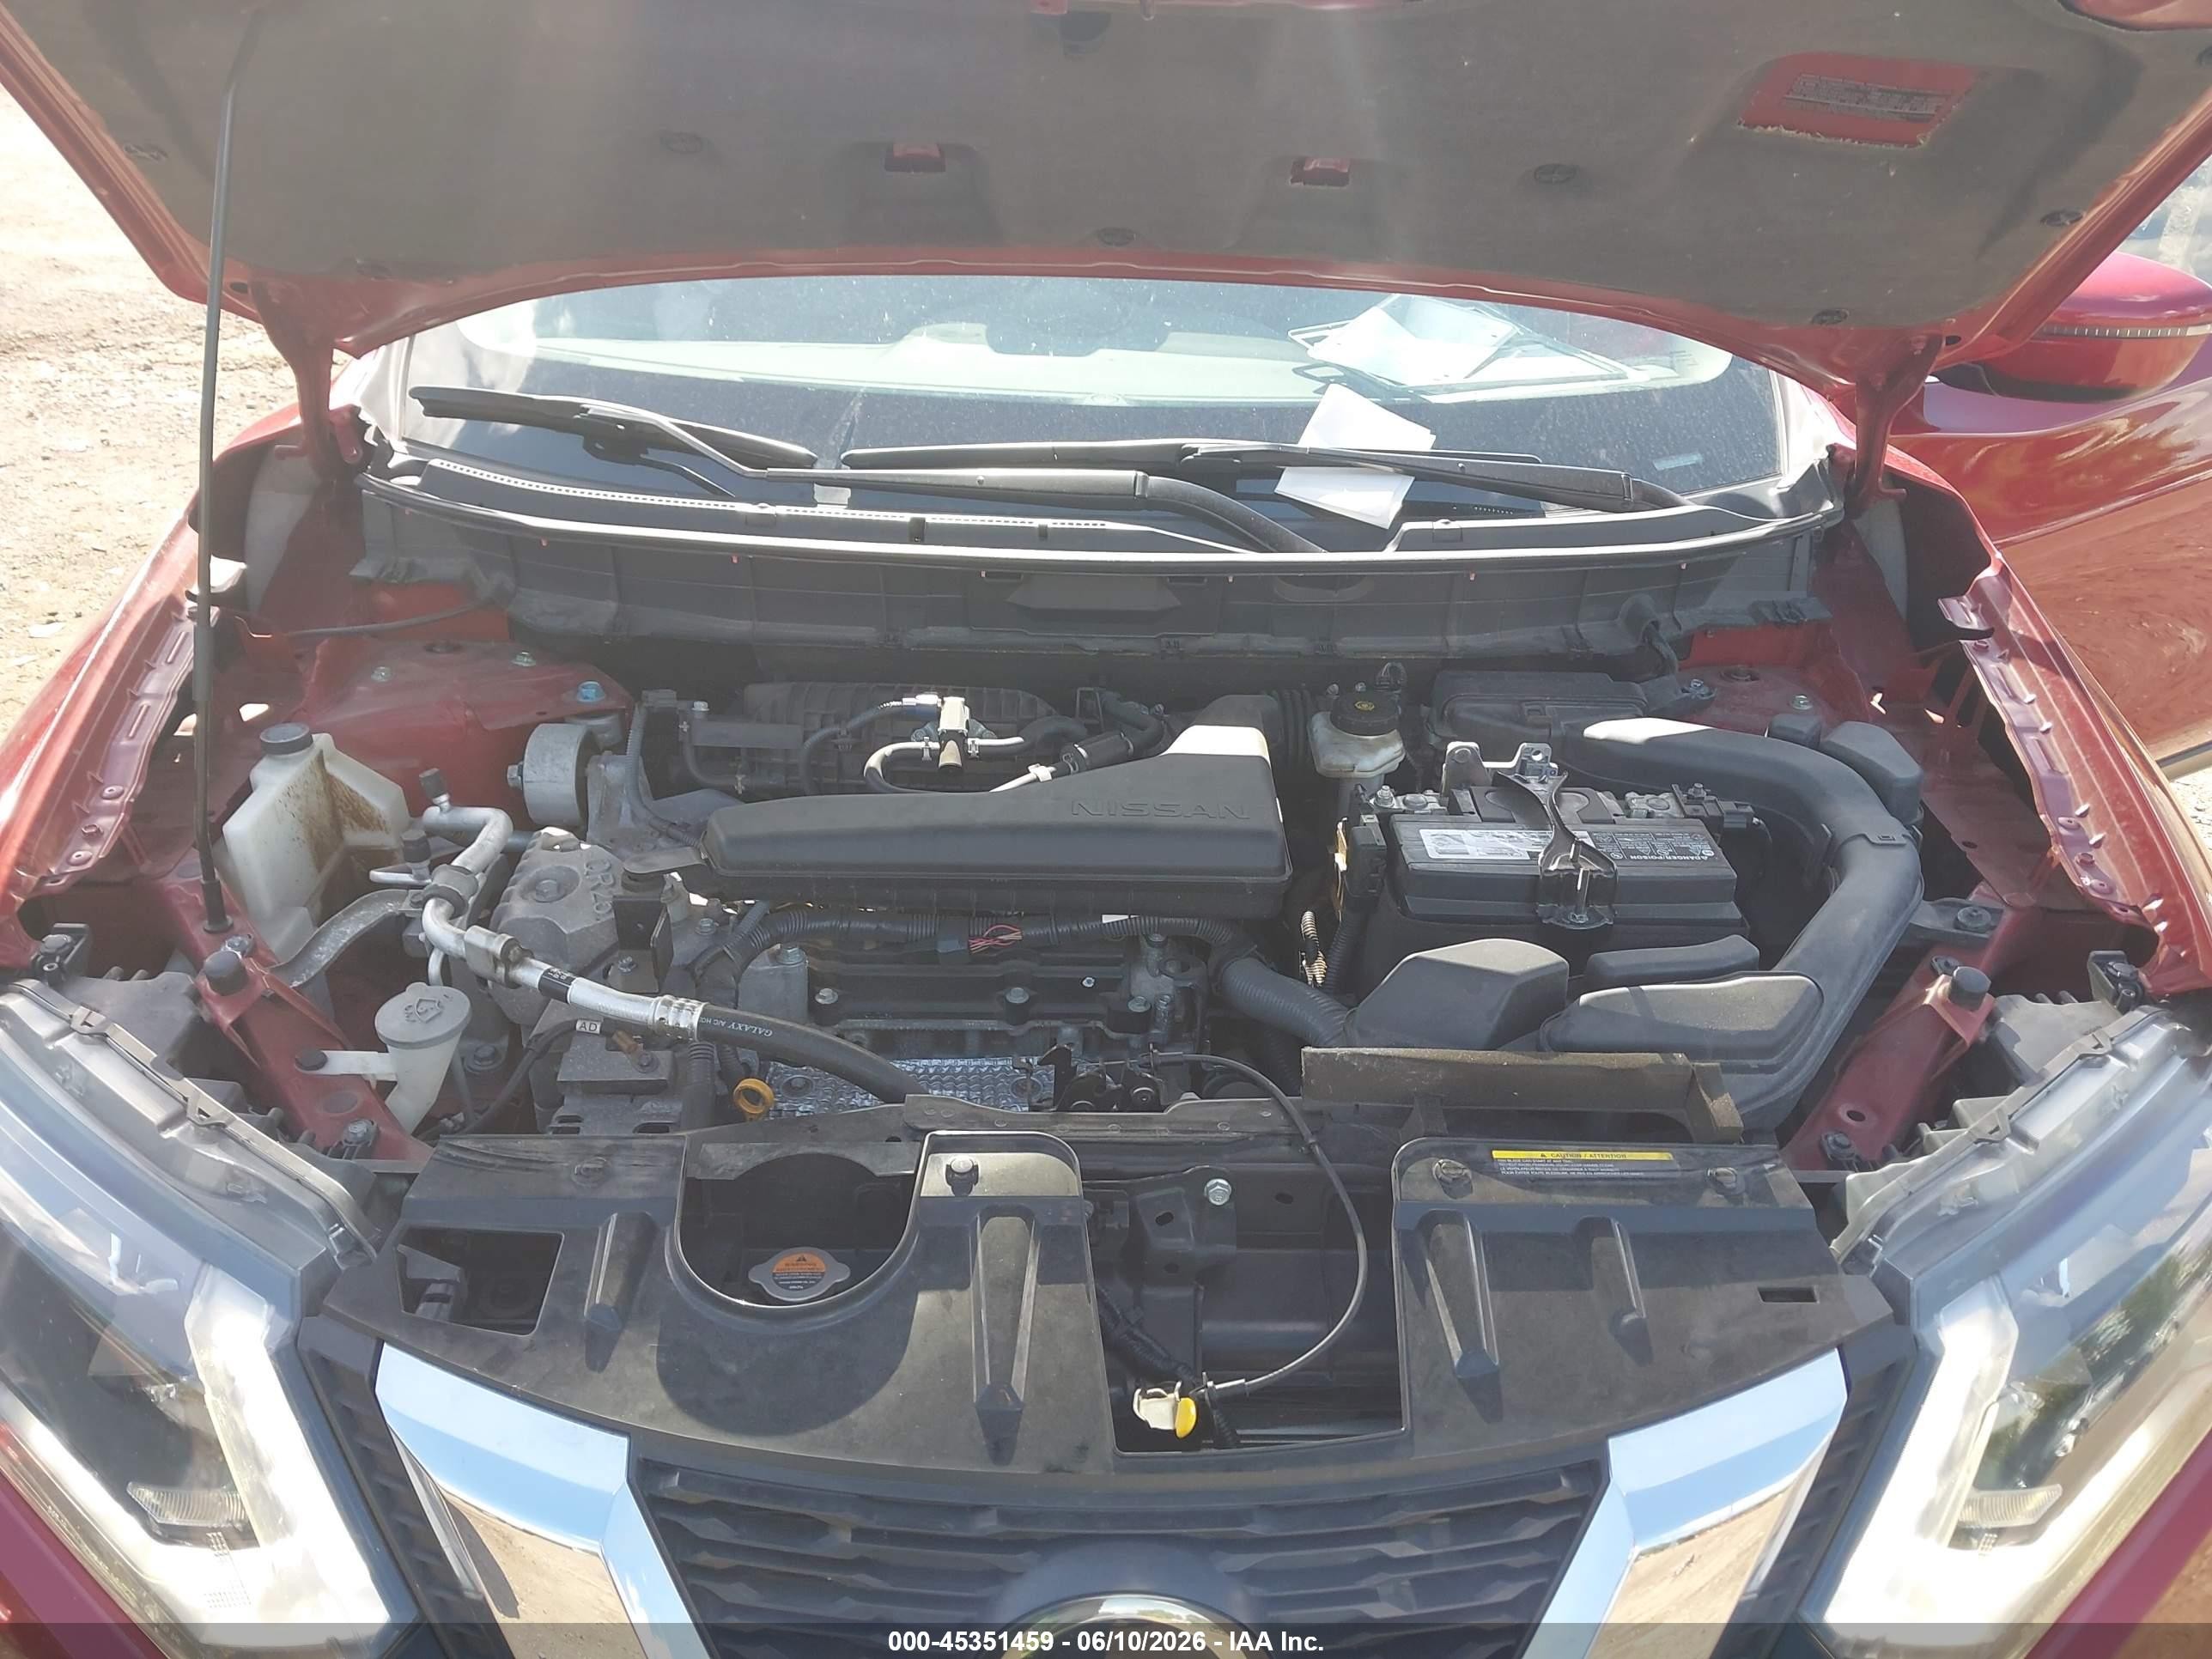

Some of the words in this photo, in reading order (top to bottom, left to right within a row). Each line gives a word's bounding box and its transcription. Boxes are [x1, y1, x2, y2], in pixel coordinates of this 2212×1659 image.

[1071, 799, 1251, 819] NISSAN
[579, 1021, 598, 1031] AD
[713, 1018, 726, 1027] A/C
[728, 1022, 773, 1037] GALAXY
